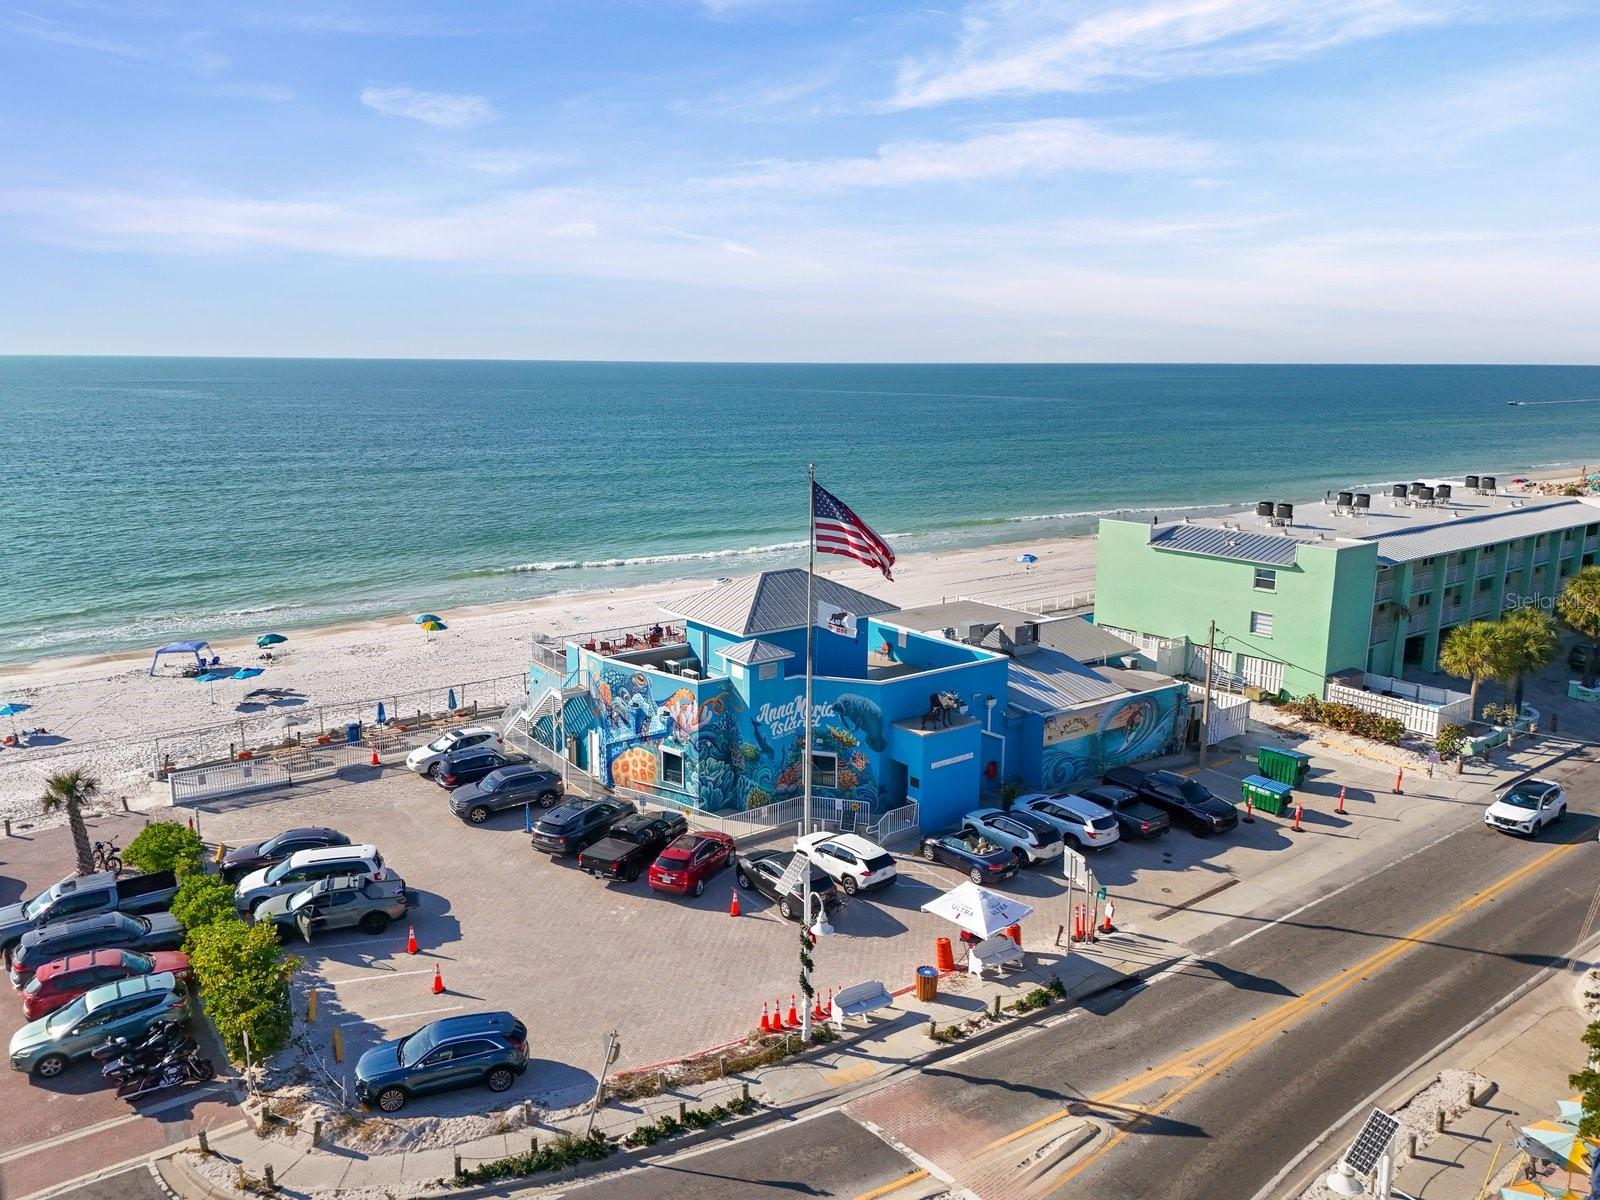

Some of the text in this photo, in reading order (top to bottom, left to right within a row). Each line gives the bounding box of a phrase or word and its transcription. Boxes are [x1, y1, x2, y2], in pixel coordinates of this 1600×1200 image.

[757, 702, 795, 725] Anna
[770, 715, 821, 736] Island
[951, 903, 974, 917] ULTRA
[990, 903, 1008, 916] ULTRA
